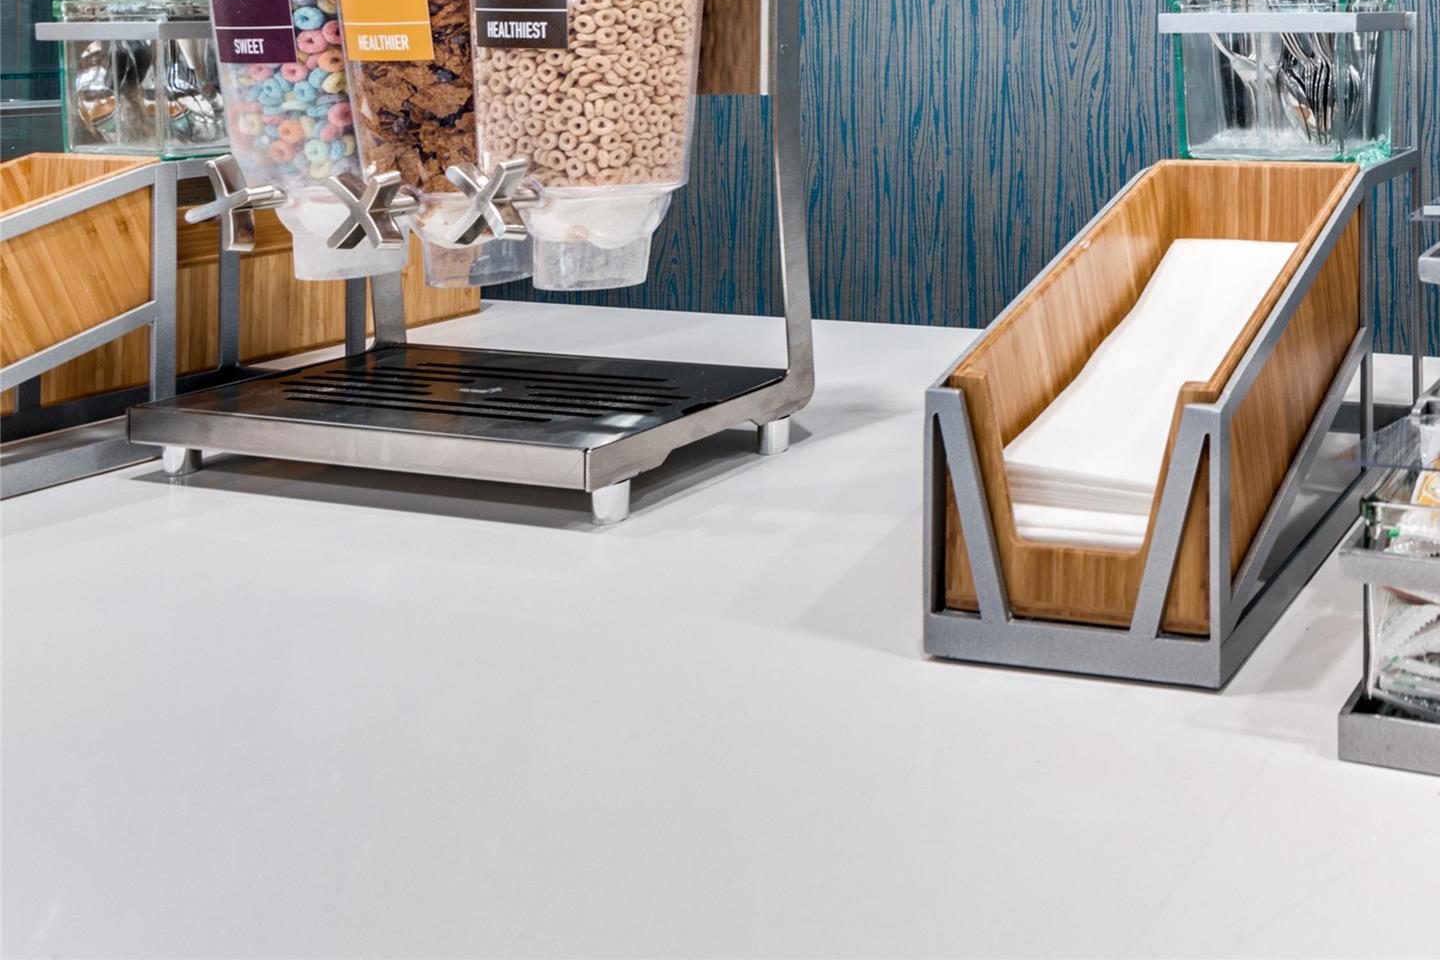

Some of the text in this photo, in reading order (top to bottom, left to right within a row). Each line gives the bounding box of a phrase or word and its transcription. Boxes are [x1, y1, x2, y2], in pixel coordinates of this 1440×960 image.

[487, 21, 548, 39] HEALTHIEST
[234, 38, 264, 54] SWEET
[358, 34, 410, 51] HEALTHIER
